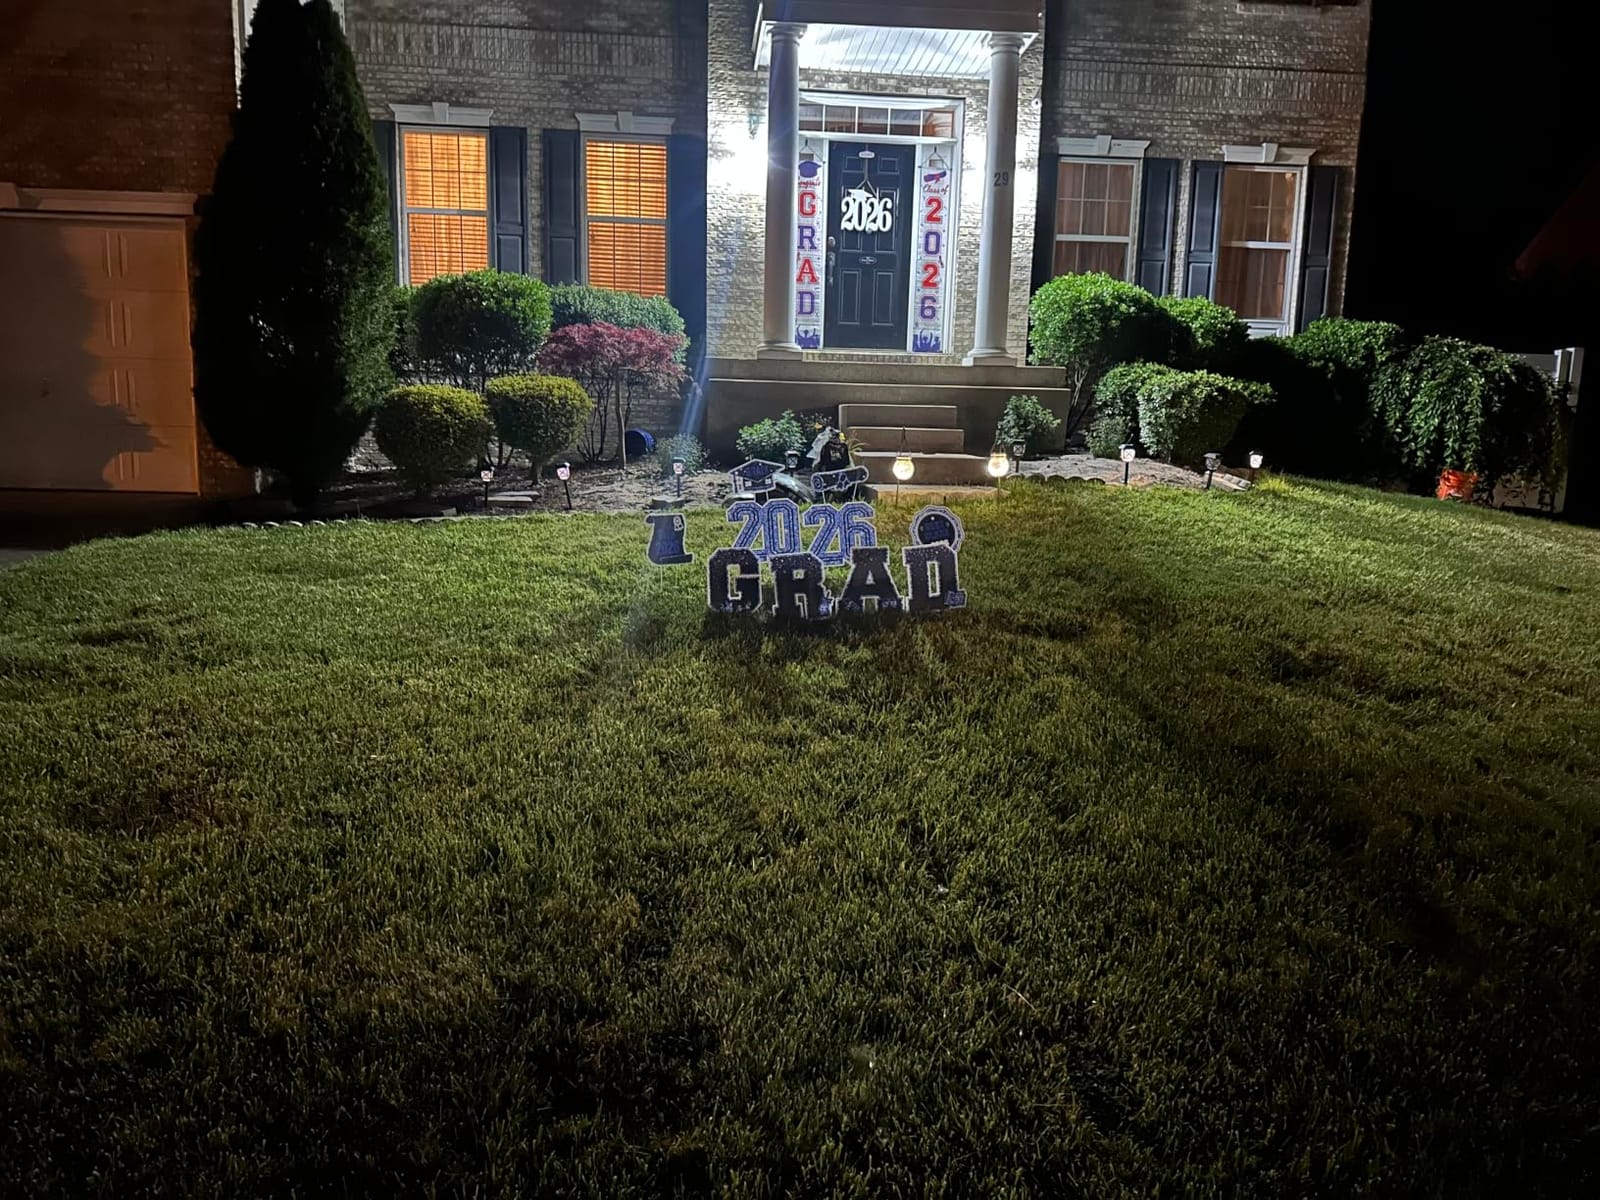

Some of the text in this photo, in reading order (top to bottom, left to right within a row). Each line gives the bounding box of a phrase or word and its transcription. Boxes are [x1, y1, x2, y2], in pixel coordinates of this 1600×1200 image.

[922, 184, 949, 195] Class of
[994, 171, 1009, 187] 29
[841, 196, 893, 232] 2026
[796, 191, 817, 315] GRAD
[919, 197, 943, 320] 2026
[726, 498, 878, 567] 2026
[707, 544, 961, 620] GRAD
